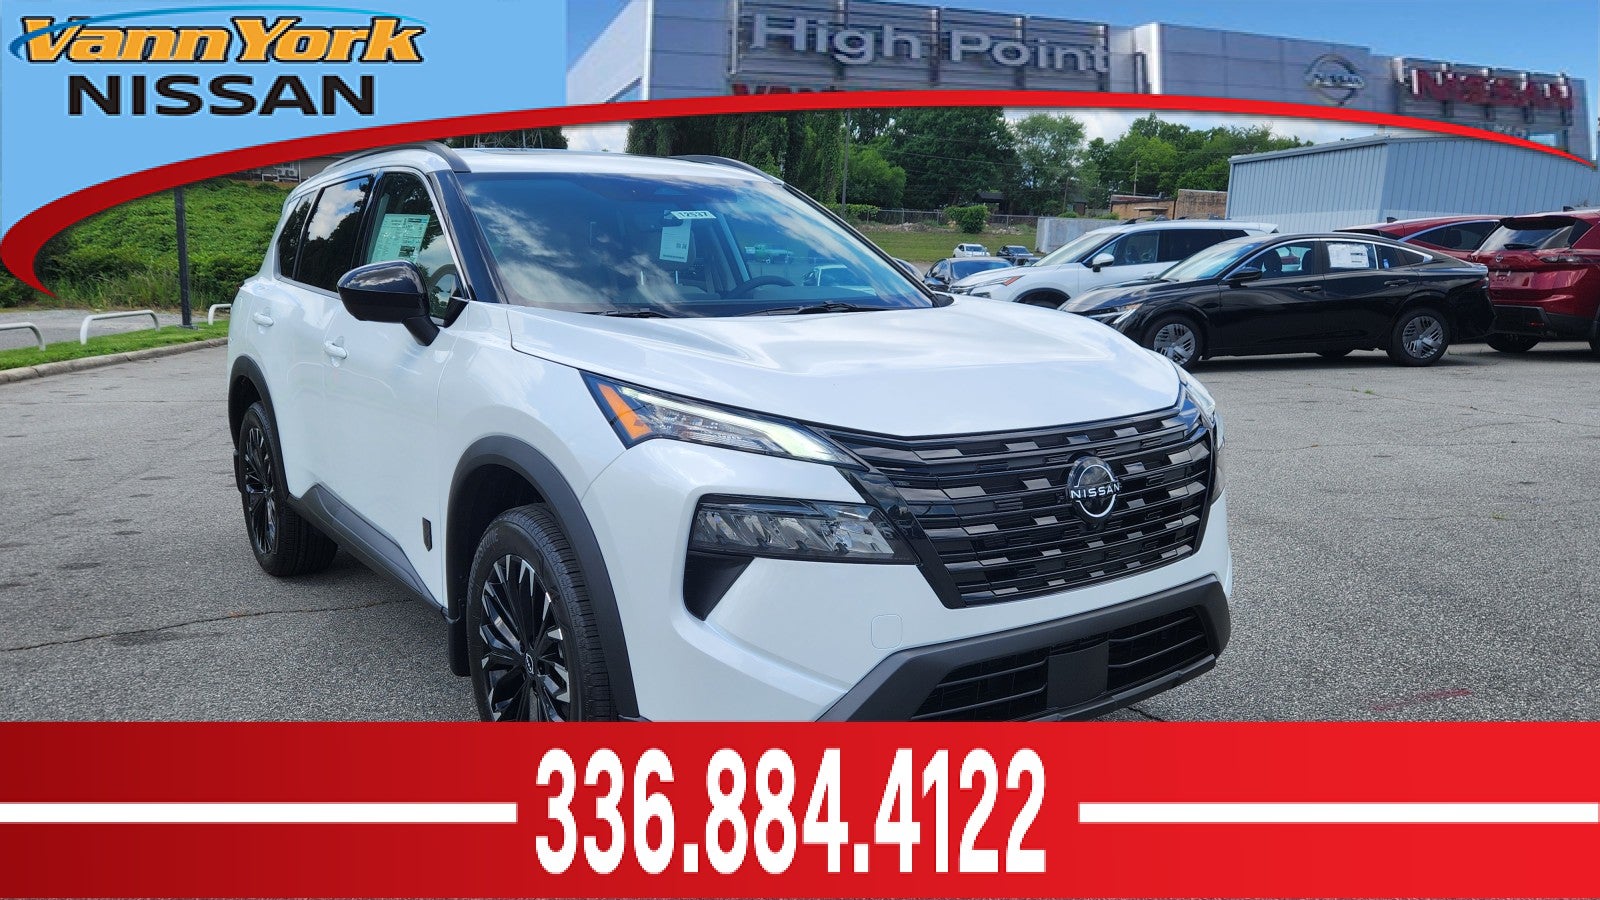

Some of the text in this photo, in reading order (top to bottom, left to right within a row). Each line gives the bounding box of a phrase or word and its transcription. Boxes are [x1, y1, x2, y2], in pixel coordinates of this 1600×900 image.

[749, 13, 1110, 73] High Point
[1070, 483, 1120, 499] NISSAN
